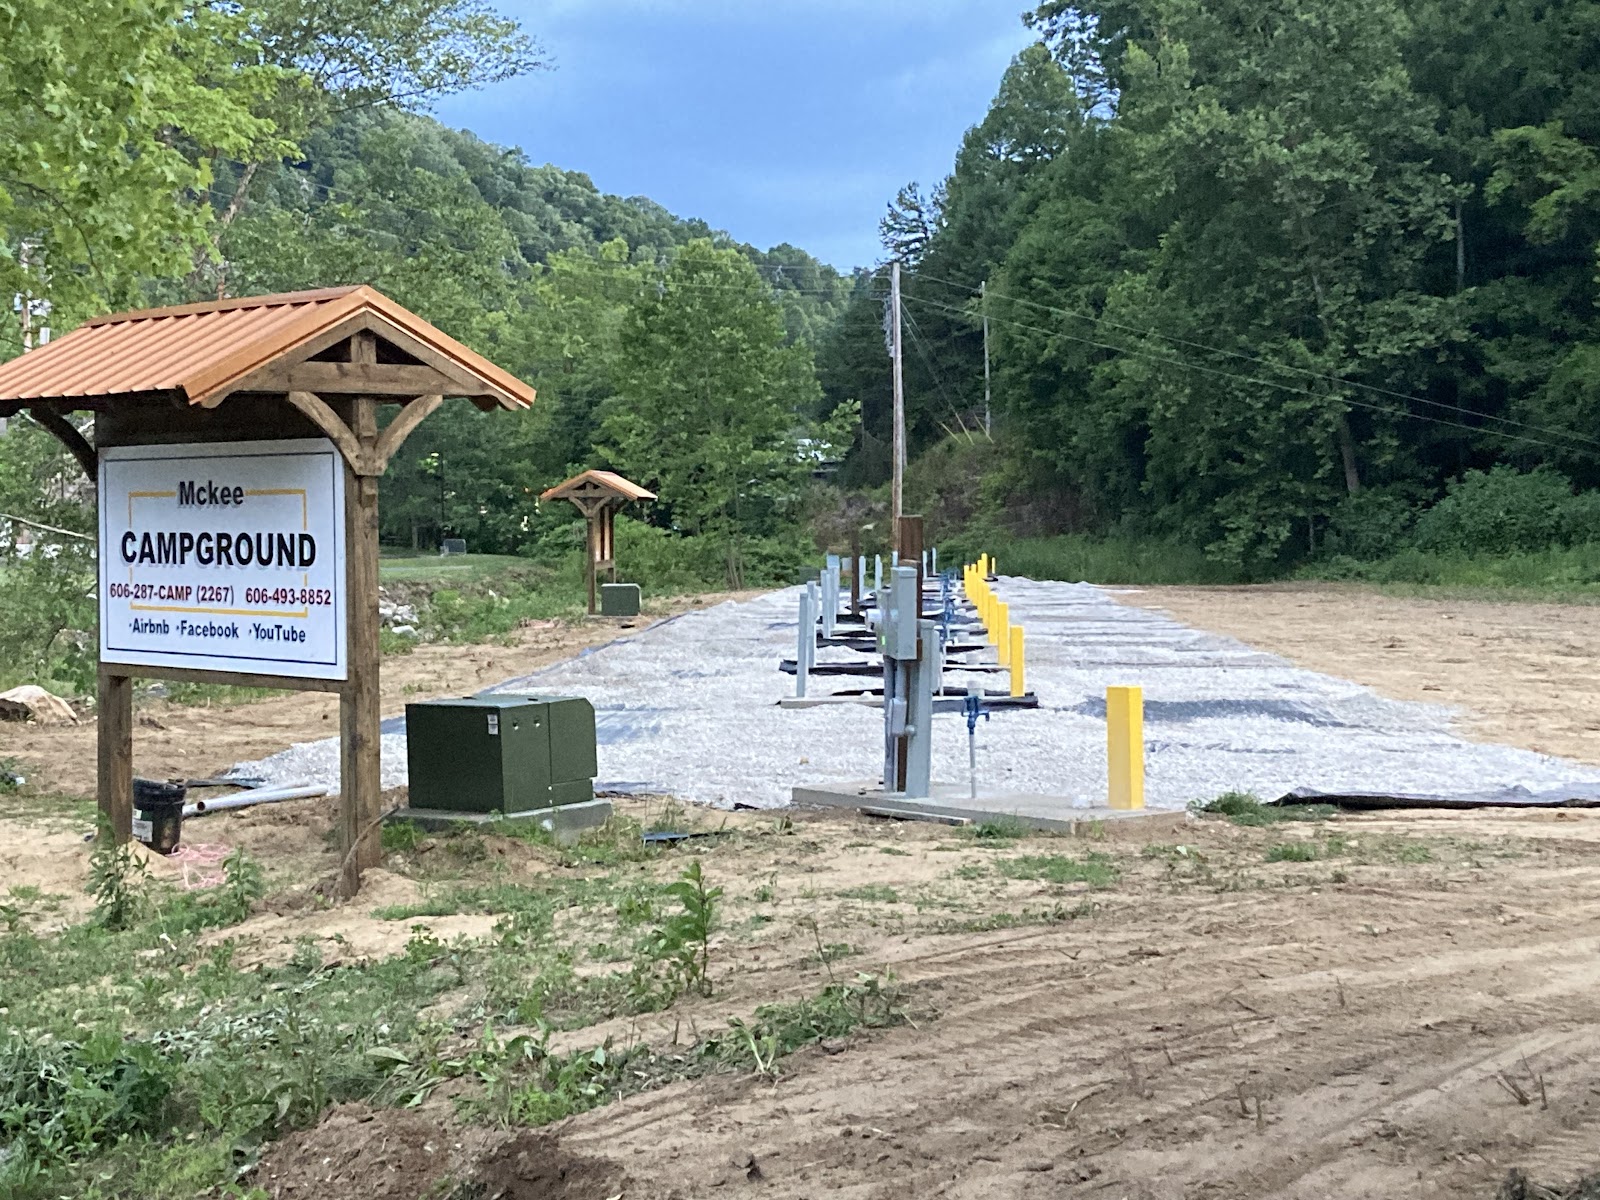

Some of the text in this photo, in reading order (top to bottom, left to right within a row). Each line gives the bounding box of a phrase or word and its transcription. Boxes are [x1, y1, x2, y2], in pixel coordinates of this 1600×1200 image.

[178, 480, 245, 505] Mckee
[121, 531, 316, 567] CAMPGROUND
[110, 583, 331, 605] 606-287-CAMP (2267) 606-493-8852
